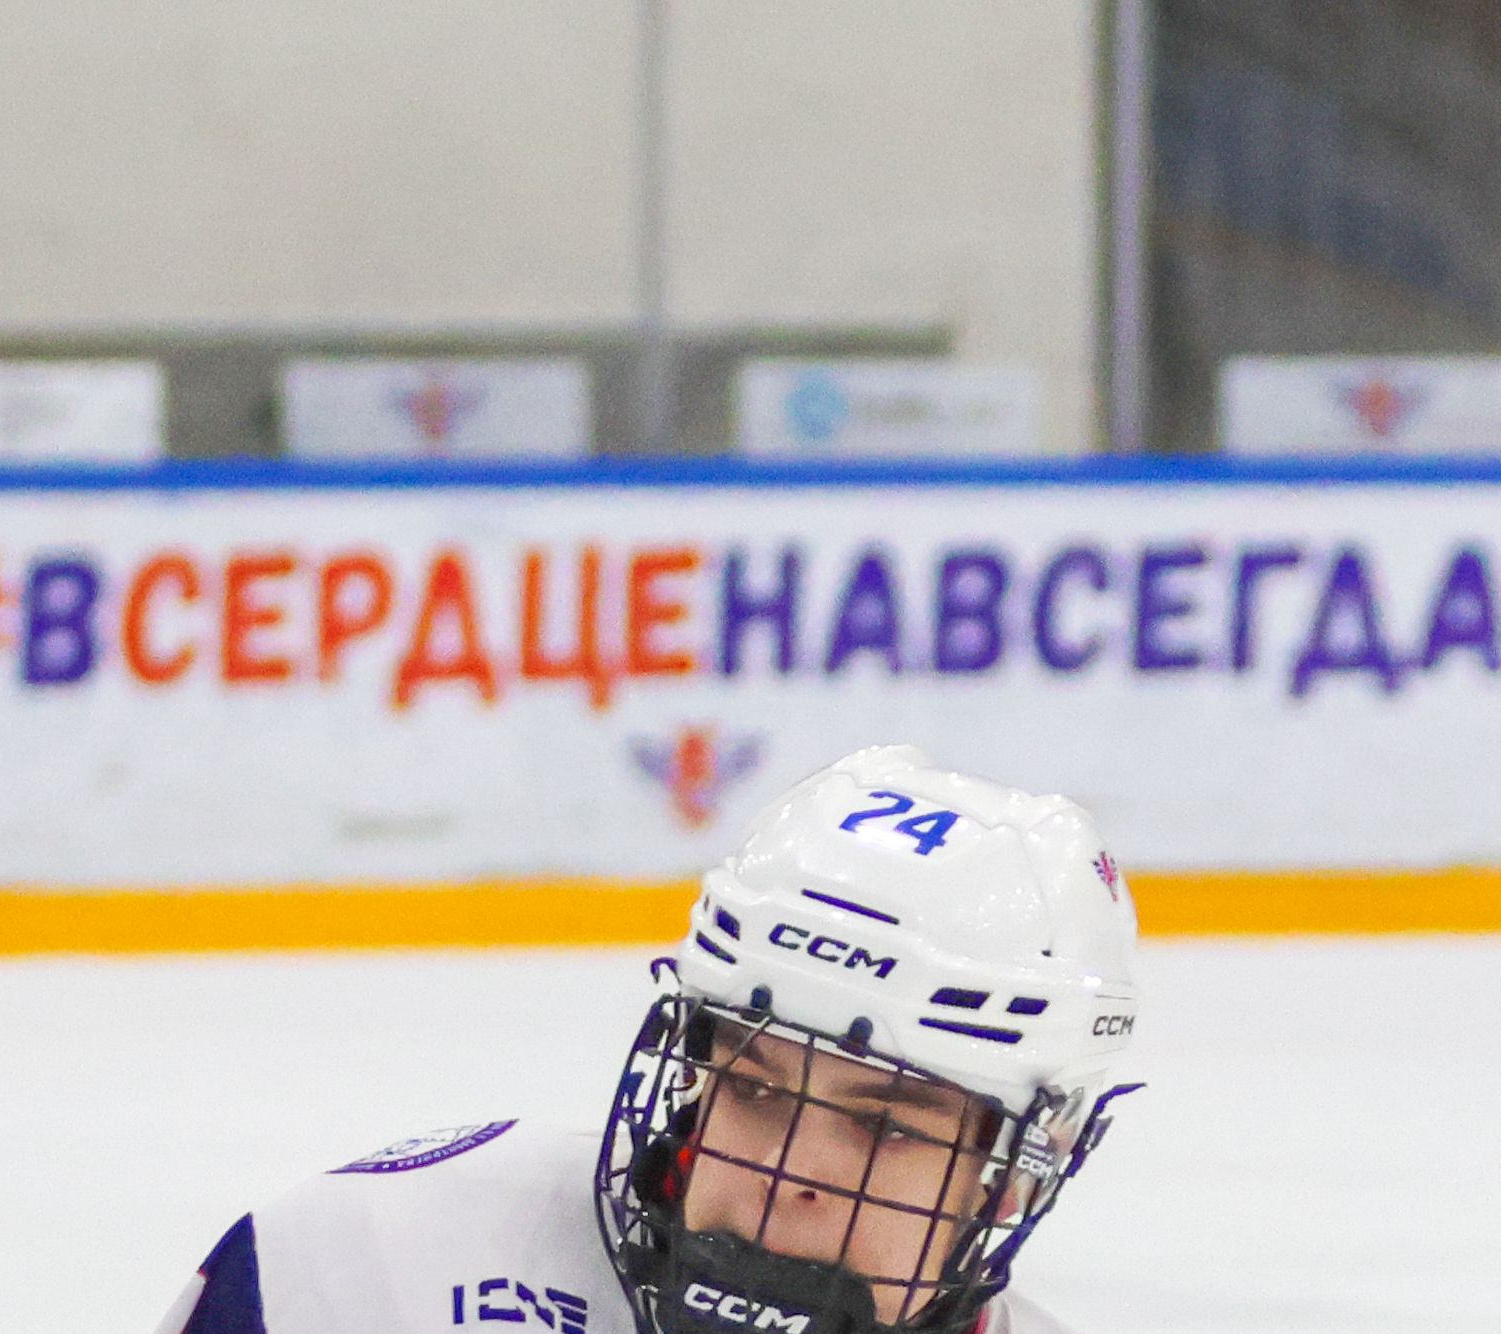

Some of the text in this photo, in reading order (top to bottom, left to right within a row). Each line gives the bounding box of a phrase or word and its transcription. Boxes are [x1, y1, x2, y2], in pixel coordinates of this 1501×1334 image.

[838, 790, 962, 856] 24
[767, 922, 899, 980] CCM
[1092, 1013, 1135, 1038] CCM
